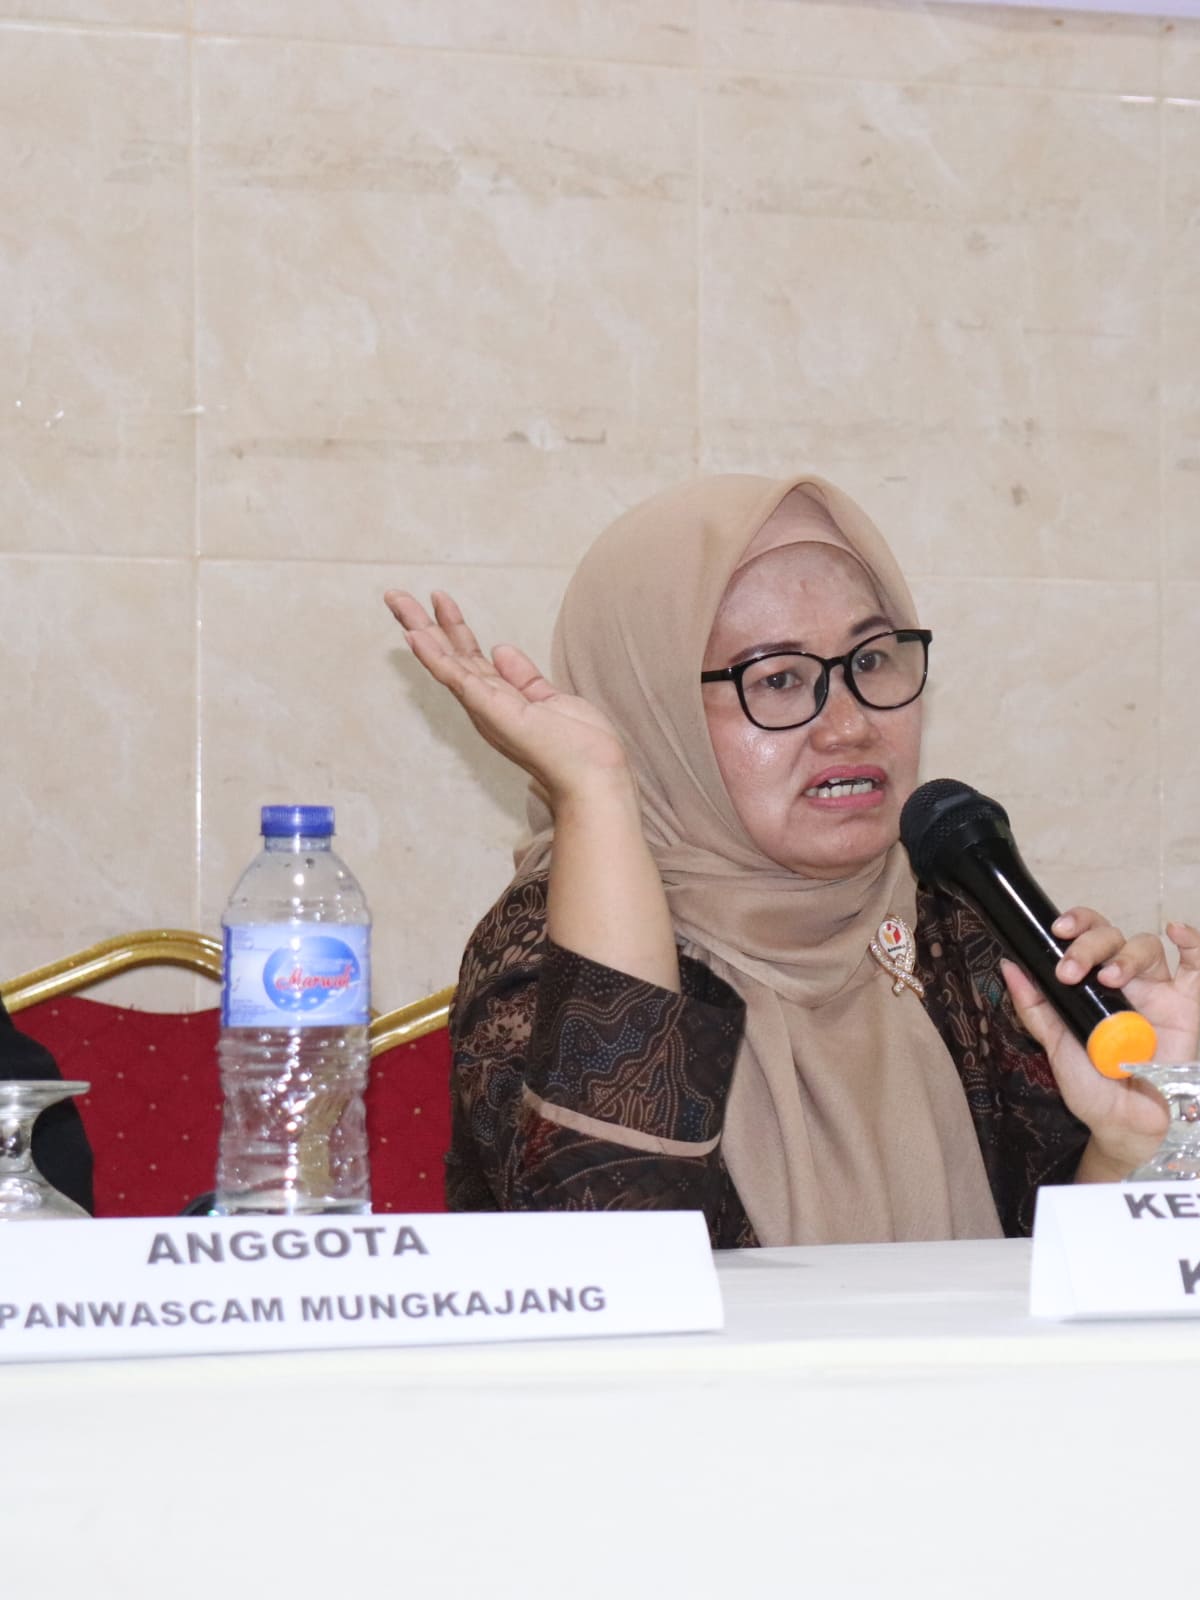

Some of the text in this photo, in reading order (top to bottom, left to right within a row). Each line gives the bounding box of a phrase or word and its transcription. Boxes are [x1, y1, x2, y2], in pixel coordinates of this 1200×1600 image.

[146, 1226, 429, 1265] ANGGOTA
[0, 1286, 606, 1329] PANWASCAM MUNGKAJANG
